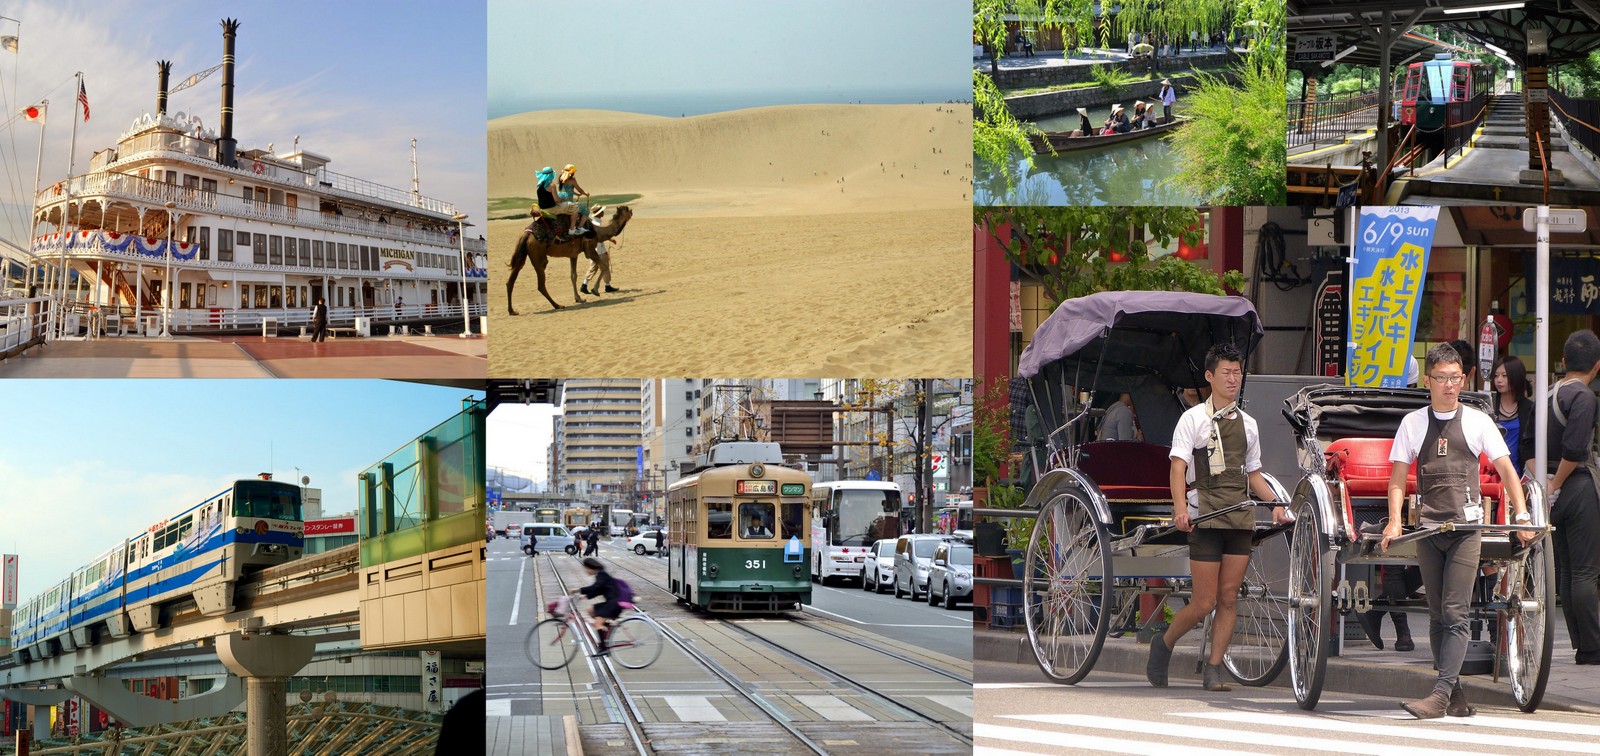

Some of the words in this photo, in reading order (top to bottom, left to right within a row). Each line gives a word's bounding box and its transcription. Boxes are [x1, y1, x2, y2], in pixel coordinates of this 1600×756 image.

[1298, 36, 1333, 50] ケーブル坂本
[1388, 206, 1410, 214] 2013
[1363, 220, 1404, 246] 6/9
[1406, 226, 1430, 237] sun
[380, 247, 415, 260] MICHIGAN
[1386, 249, 1421, 369] 水上スキー
[1362, 265, 1396, 384] 水上バイク
[752, 484, 774, 492] 広島駅
[745, 559, 766, 569] 351
[426, 661, 439, 703] 福さ屋
